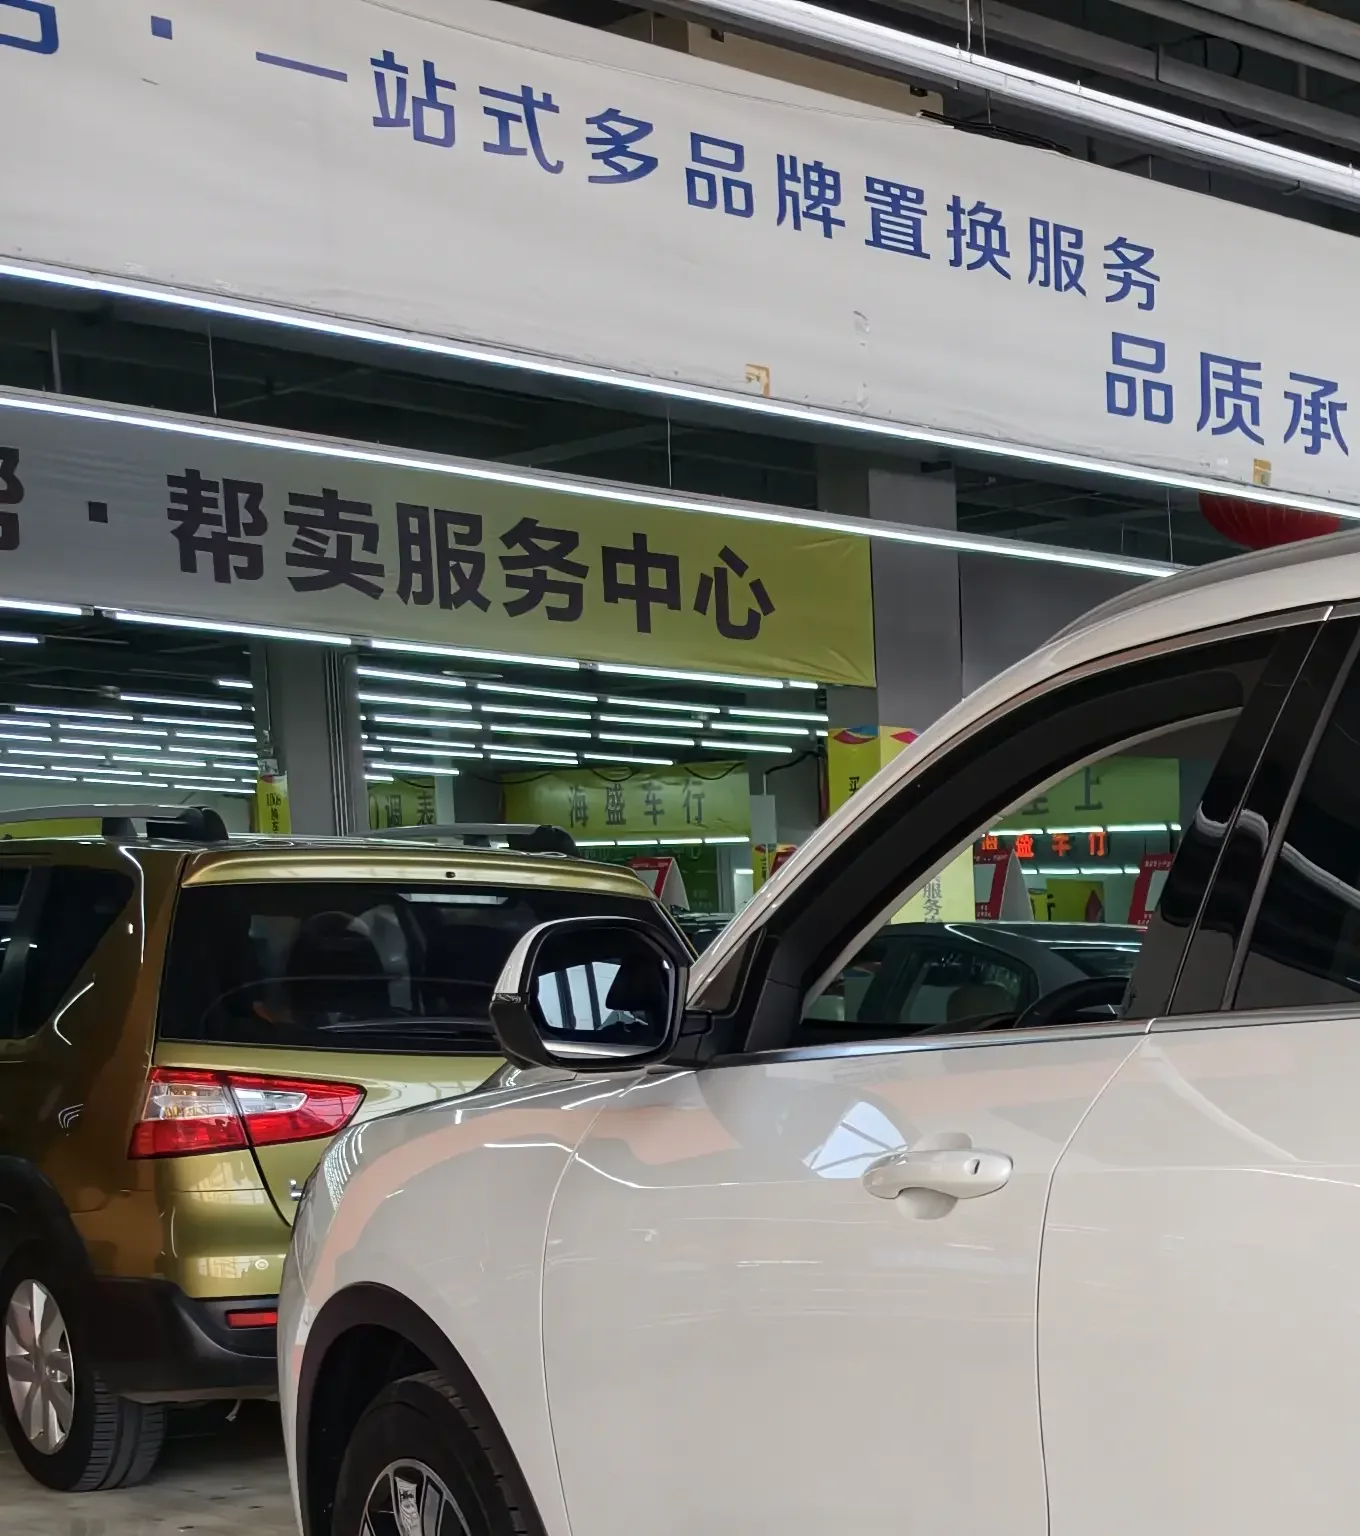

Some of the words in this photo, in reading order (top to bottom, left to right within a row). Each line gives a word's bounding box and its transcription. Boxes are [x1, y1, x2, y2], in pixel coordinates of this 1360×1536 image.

[0, 446, 777, 642] ·帮卖服务中心
[567, 778, 706, 829] 海盛车行
